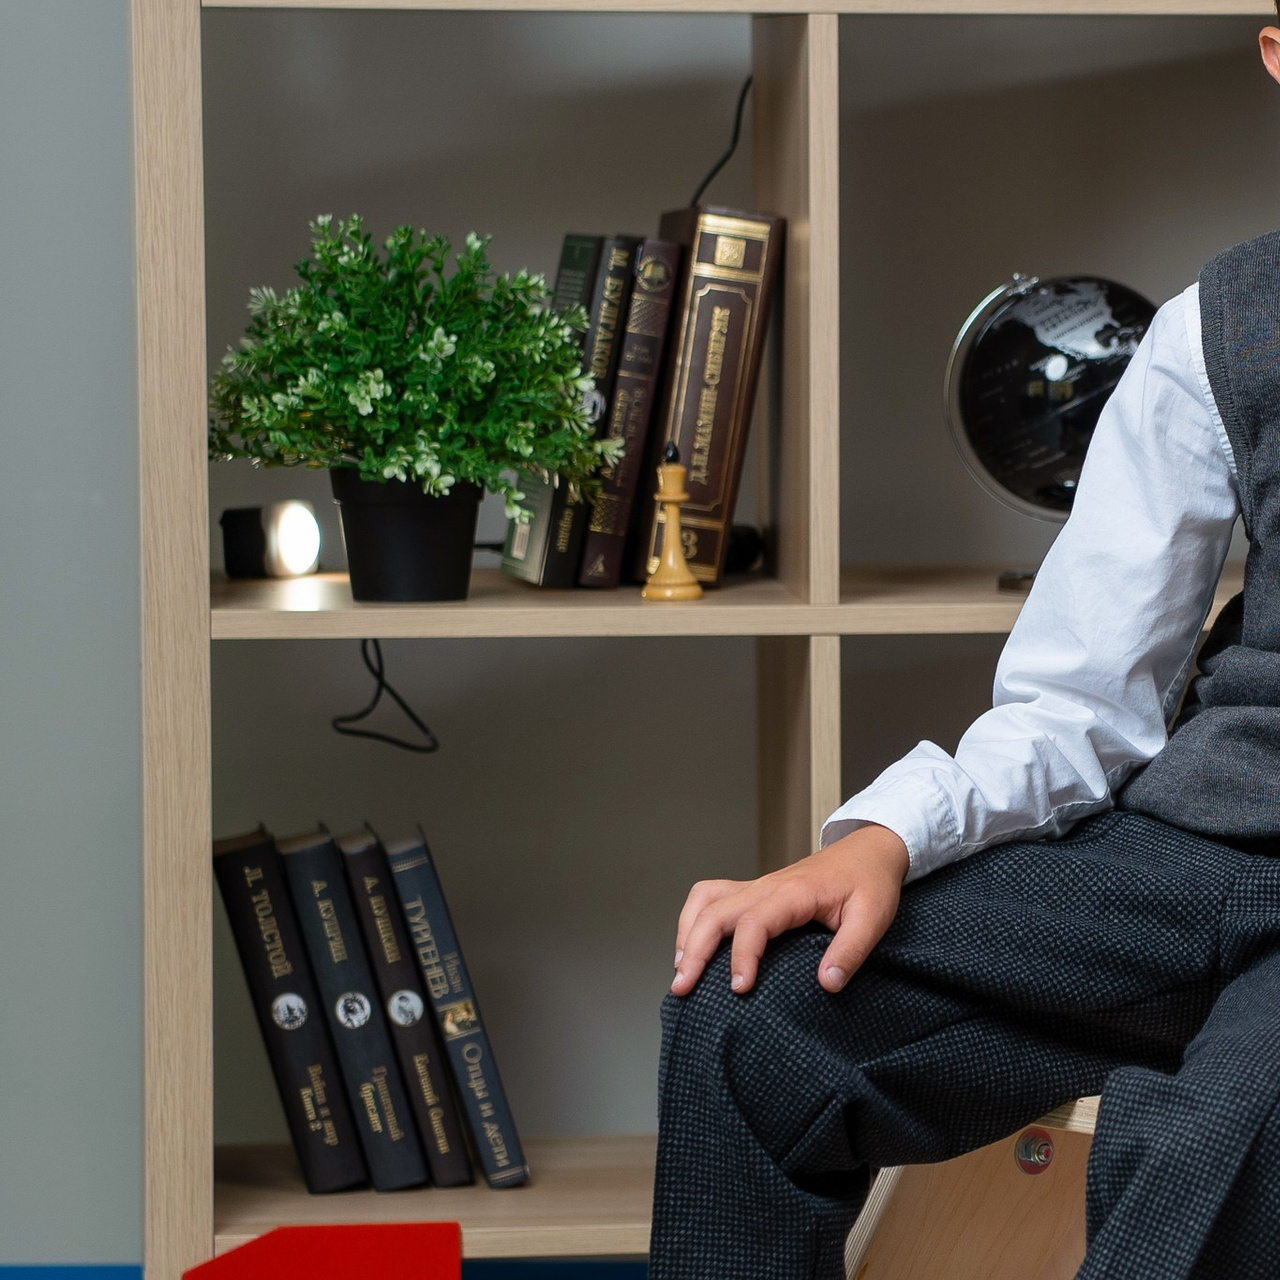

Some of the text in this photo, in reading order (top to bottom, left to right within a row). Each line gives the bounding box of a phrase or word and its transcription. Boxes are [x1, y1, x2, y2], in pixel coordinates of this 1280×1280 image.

[590, 248, 630, 380] М. БУЛГАКОВ
[243, 866, 293, 979] Л. ТОЛСТОЙ
[312, 879, 348, 963] А. КУПРИН
[362, 876, 401, 964] А. ПУШКИН
[404, 895, 451, 1000] ТУРГЕНЕВ
[443, 951, 464, 994] Иван
[359, 1081, 383, 1134] браслет
[461, 1042, 488, 1099] Отцы
[481, 1121, 510, 1168] дети
